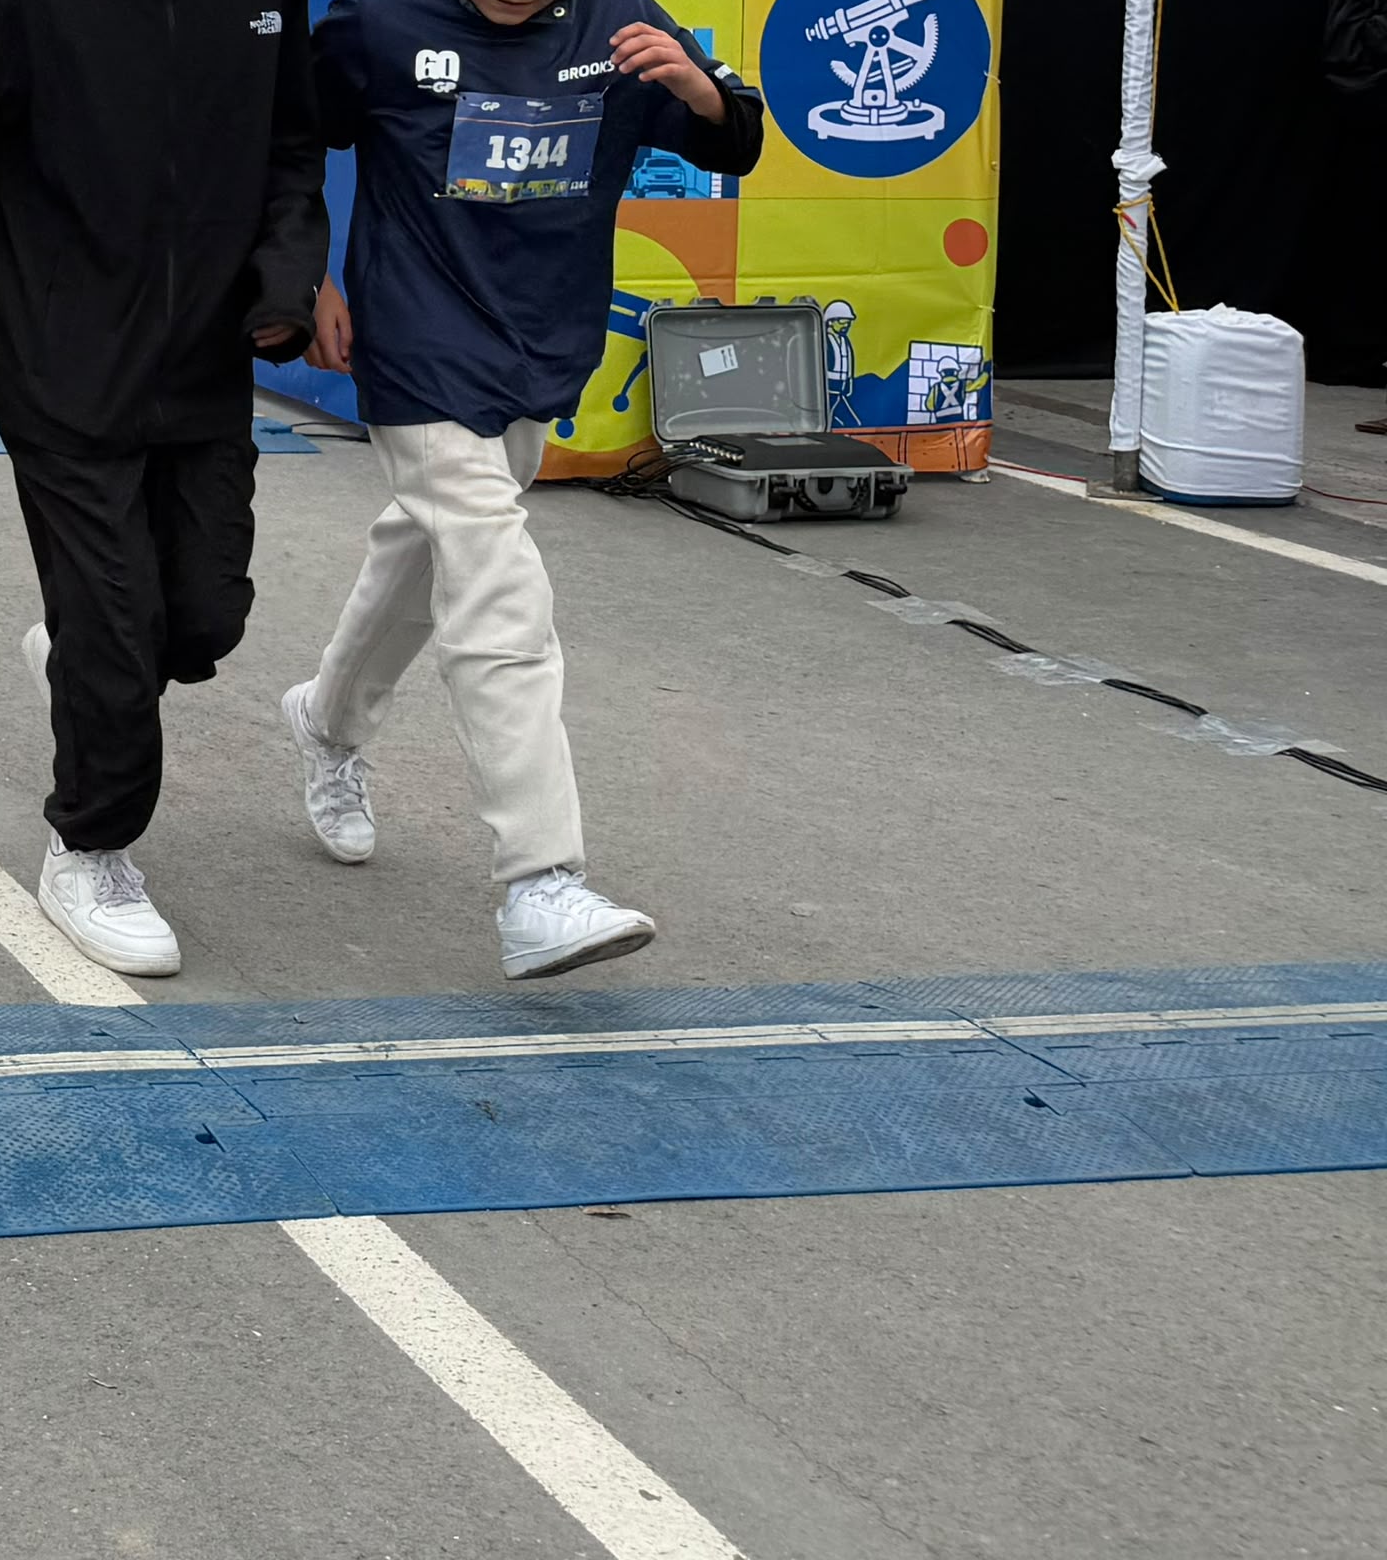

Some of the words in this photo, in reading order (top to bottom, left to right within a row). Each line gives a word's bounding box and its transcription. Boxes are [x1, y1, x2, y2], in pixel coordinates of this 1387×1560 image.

[415, 49, 460, 83] 60
[557, 59, 615, 83] BROOKS
[432, 81, 458, 93] GP
[485, 134, 569, 172] 1344
